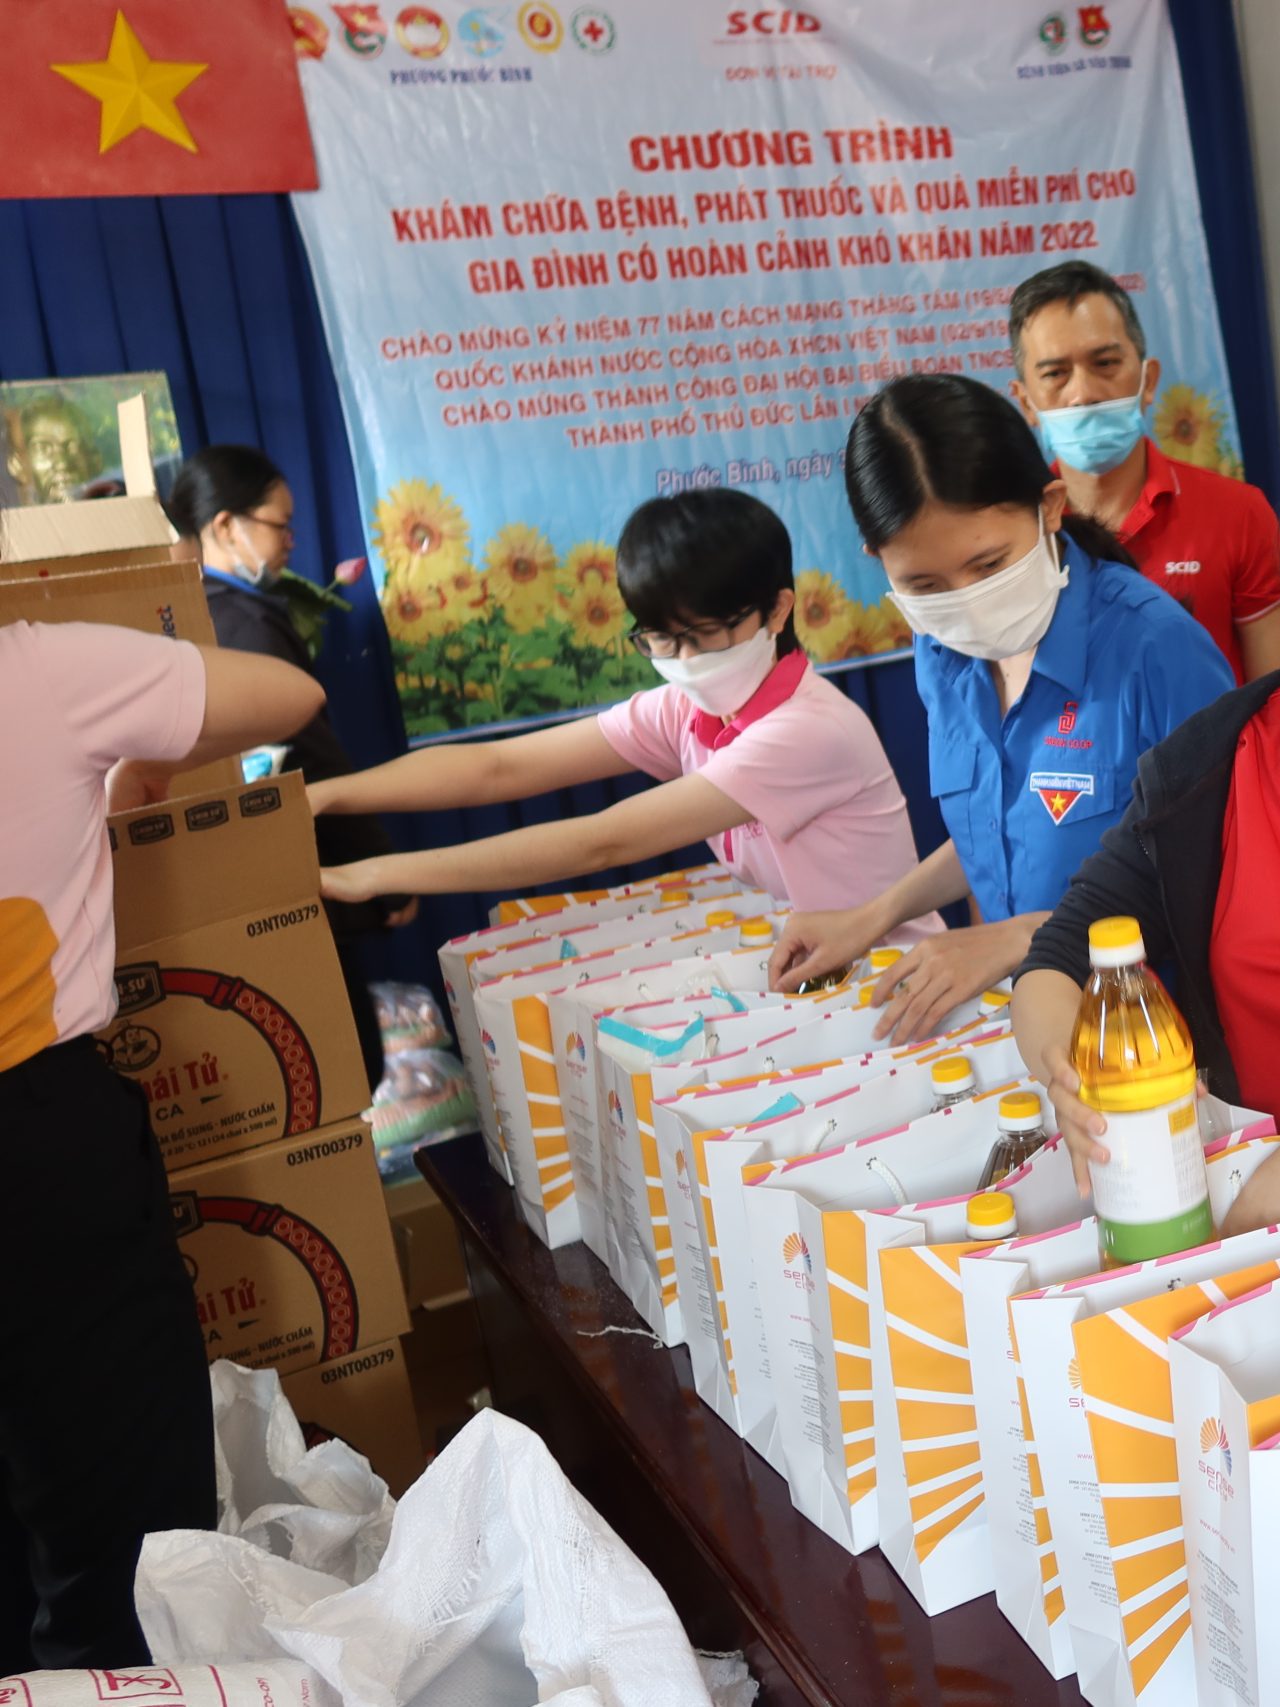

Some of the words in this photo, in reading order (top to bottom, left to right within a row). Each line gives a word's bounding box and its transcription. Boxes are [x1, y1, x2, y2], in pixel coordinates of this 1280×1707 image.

[727, 9, 822, 35] SCID
[629, 129, 813, 172] CHƯƠNG
[824, 119, 953, 166] TRÌNH
[391, 198, 493, 244] KHÁM
[501, 192, 589, 237] CHỮA
[597, 189, 689, 237] BỆNH,
[694, 185, 768, 226] PHÁT
[777, 175, 863, 218] THUỐC
[870, 180, 907, 215] VÀ
[916, 173, 972, 213] QUÀ
[978, 165, 1040, 208] MIỄN
[1046, 169, 1083, 203] PHÍ
[1086, 168, 1137, 200] CHO
[468, 260, 526, 295] GIA
[532, 247, 608, 291] ĐÌNH
[617, 244, 658, 284] CÓ
[667, 237, 748, 279] HOÀN
[756, 228, 830, 272] CẢNH
[838, 227, 893, 266] KHÓ
[899, 226, 973, 263] KHĂN
[980, 222, 1035, 258] NĂM
[1040, 219, 1098, 252] 2022
[381, 331, 452, 361] CHÀO
[459, 324, 531, 353] MỪNG
[575, 314, 632, 343] NIỆM
[637, 316, 661, 338] 77
[667, 306, 715, 333] NĂM
[721, 300, 780, 330] CÁCH
[786, 300, 843, 324] MẠNG
[848, 293, 918, 318] THÁNG
[921, 287, 960, 312] TÁM
[435, 357, 504, 392] QUỐC
[512, 353, 594, 384] KHÁNH
[600, 345, 663, 375] NƯỚC
[669, 340, 732, 371] CỘNG
[738, 336, 782, 361] HÒA
[788, 333, 841, 356] XHCN
[846, 325, 889, 351] VIỆT
[896, 324, 935, 345] NAM
[442, 396, 512, 428] CHÀO
[518, 390, 587, 419] MỪNG
[592, 382, 669, 412] THÀNH
[675, 376, 737, 402] CÔNG
[743, 372, 778, 395] ĐẠI
[784, 366, 819, 391] HỘI
[565, 420, 645, 450] THÀNH
[651, 407, 696, 440] PHỐ
[702, 403, 744, 434] THỦ
[750, 397, 795, 427] ĐỨC
[801, 392, 838, 421] LẦN
[655, 463, 722, 496] Phước
[727, 456, 780, 486] Bình,
[786, 449, 833, 481] ngày
[1164, 561, 1201, 575] SCID
[246, 904, 319, 938] 03NT00379
[183, 1052, 219, 1090] Tử
[286, 1134, 363, 1167] 03NT00379
[320, 1348, 395, 1385] 03NT00379
